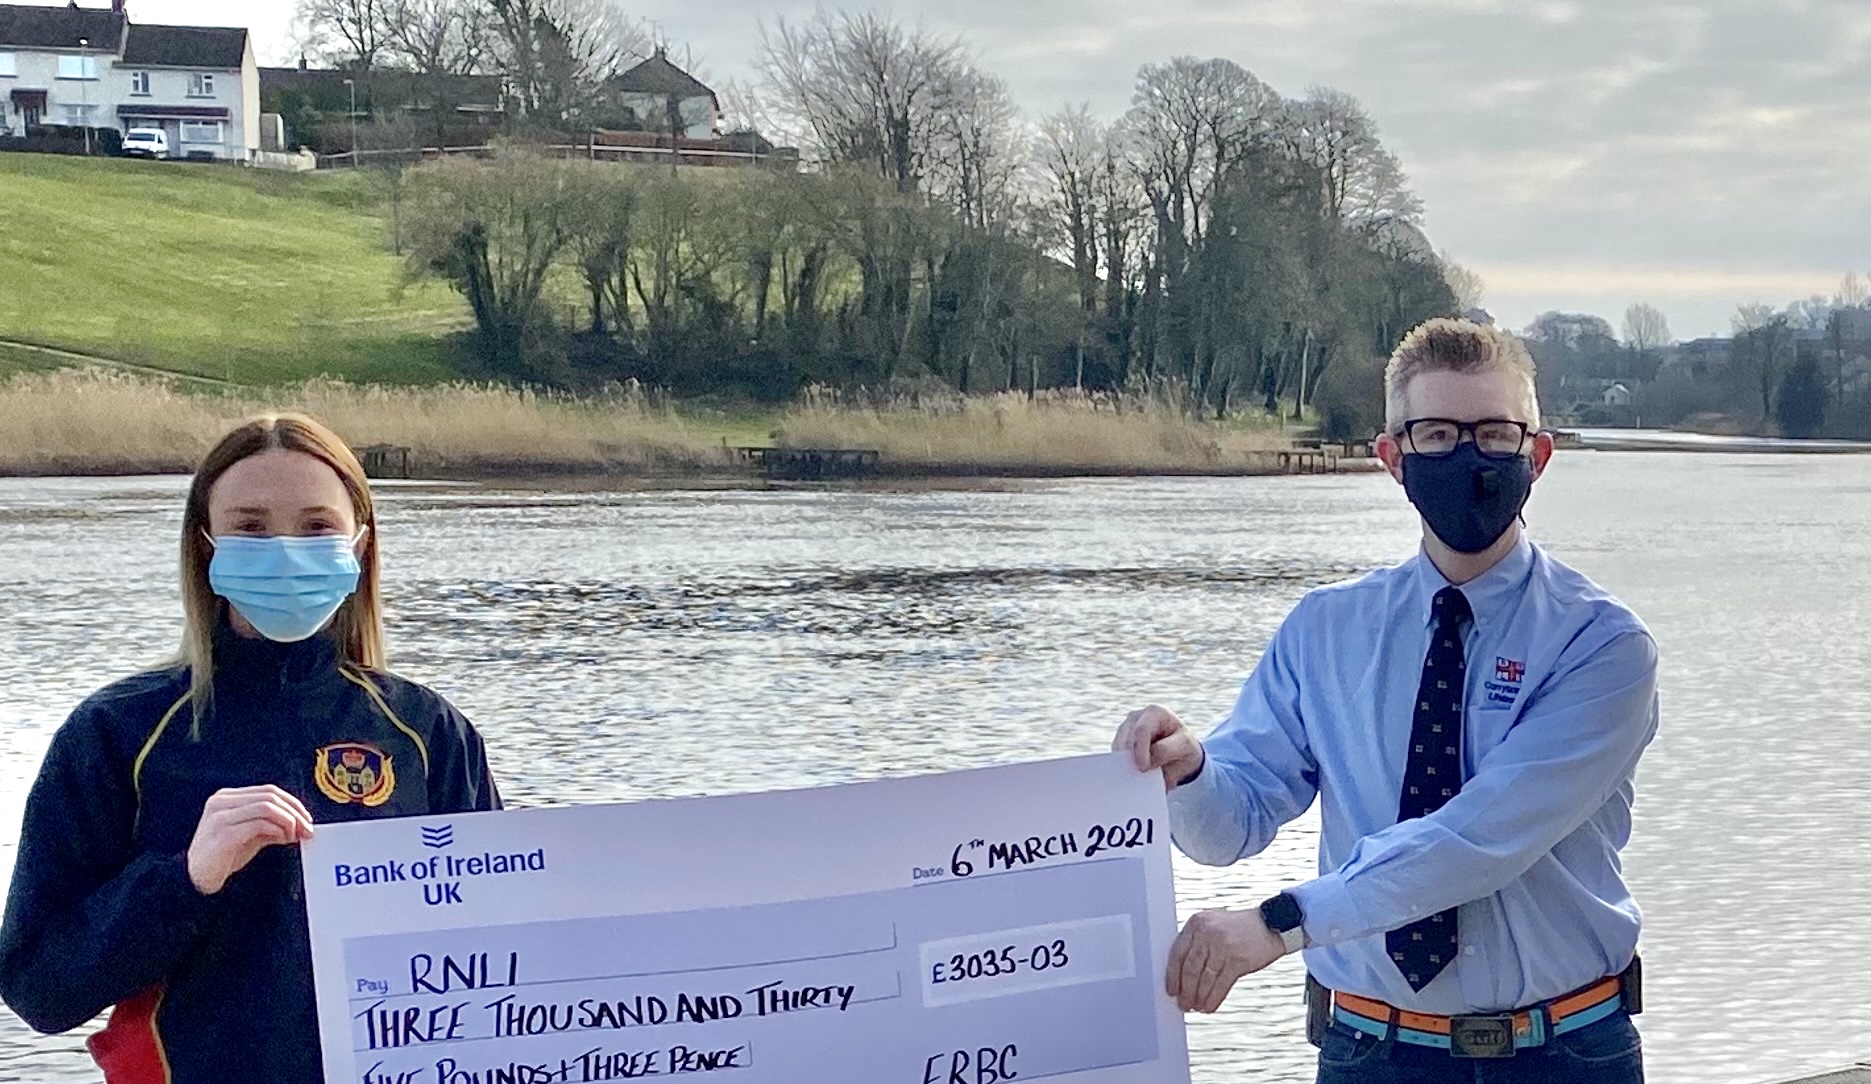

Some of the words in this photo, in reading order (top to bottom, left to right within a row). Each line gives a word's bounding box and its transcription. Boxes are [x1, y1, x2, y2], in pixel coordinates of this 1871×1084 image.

[988, 832, 1078, 871] MARCH
[1084, 818, 1155, 858] 2021
[335, 859, 407, 888] Bank
[411, 855, 441, 881] of
[446, 848, 546, 878] Ireland
[912, 864, 945, 881] Date
[423, 882, 464, 906] UK
[355, 976, 390, 996] Pay
[409, 950, 519, 995] RNLI
[354, 998, 471, 1051] THREE
[484, 993, 668, 1040] THOUSAND
[675, 991, 743, 1025] AND
[745, 979, 856, 1018] THIRTY
[667, 1044, 746, 1074] PENCE
